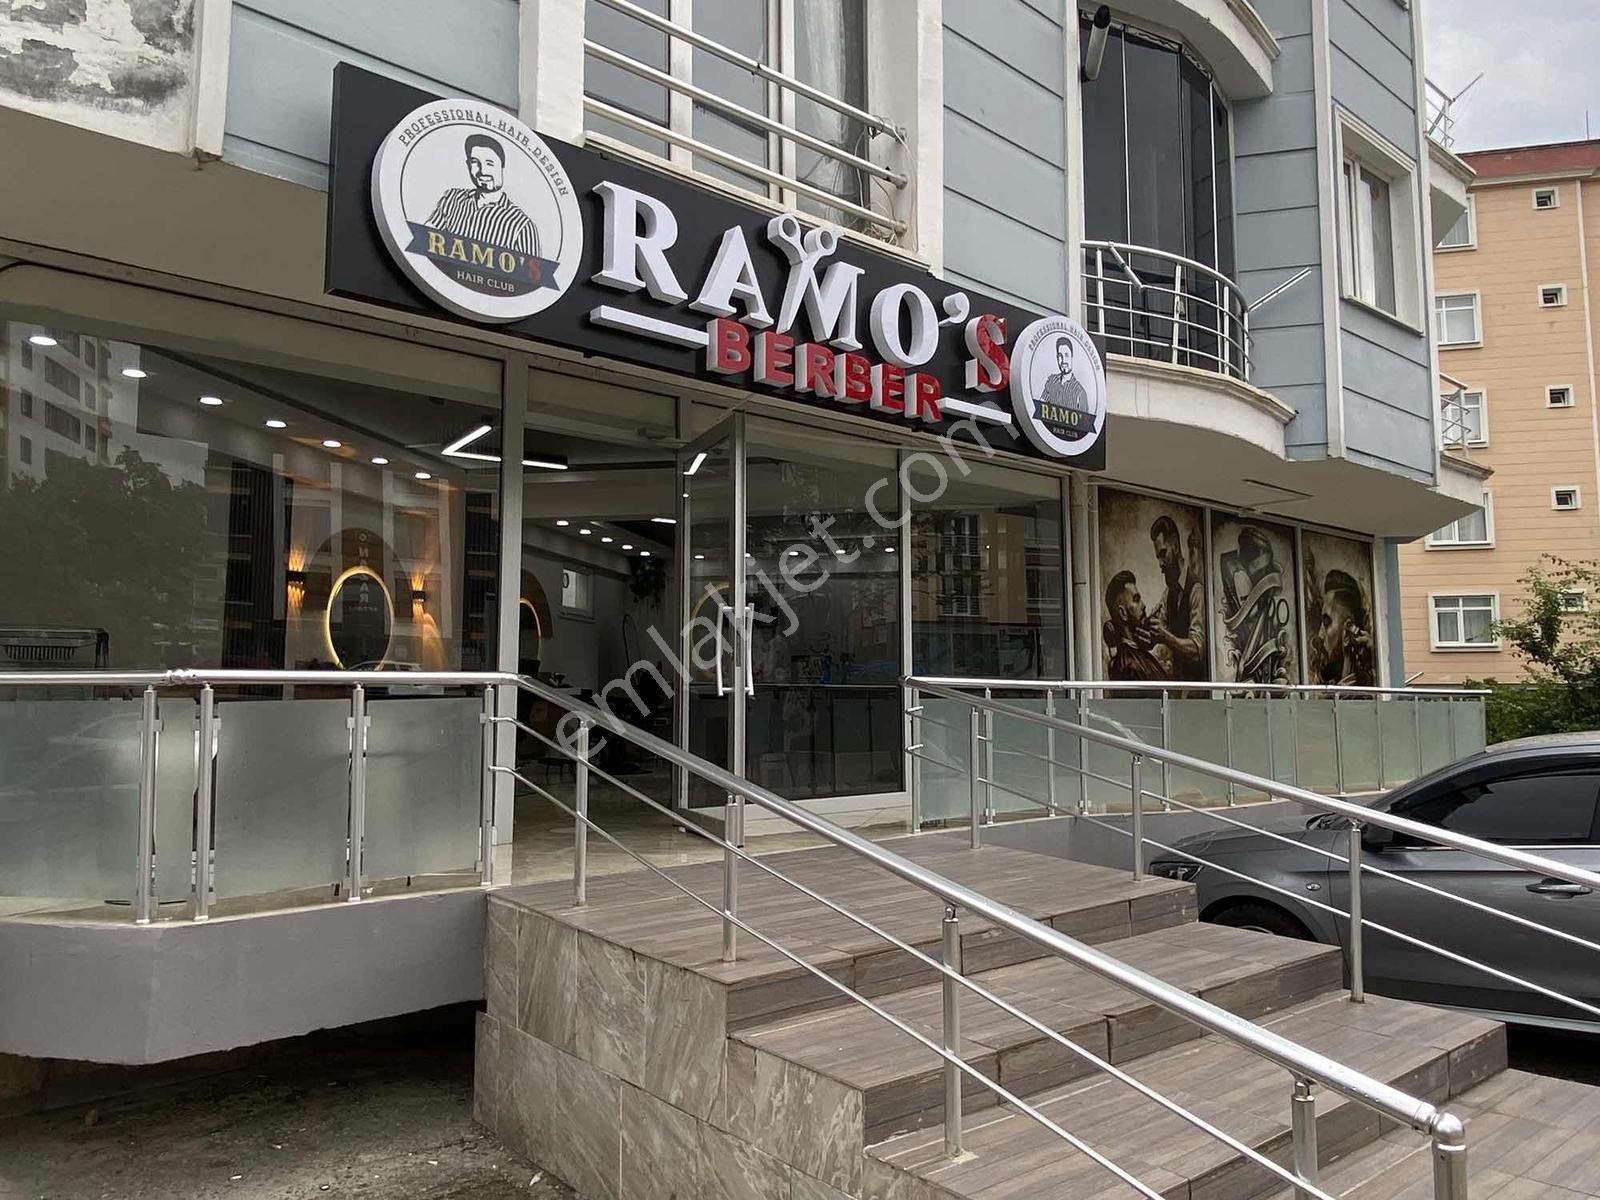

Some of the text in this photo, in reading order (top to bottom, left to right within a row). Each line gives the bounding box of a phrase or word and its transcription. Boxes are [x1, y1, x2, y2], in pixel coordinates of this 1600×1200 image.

[427, 231, 542, 282] RAMO'S
[457, 271, 515, 292] HAIR CLUB
[591, 180, 1009, 392] RAMO'S
[705, 317, 942, 422] BERBER
